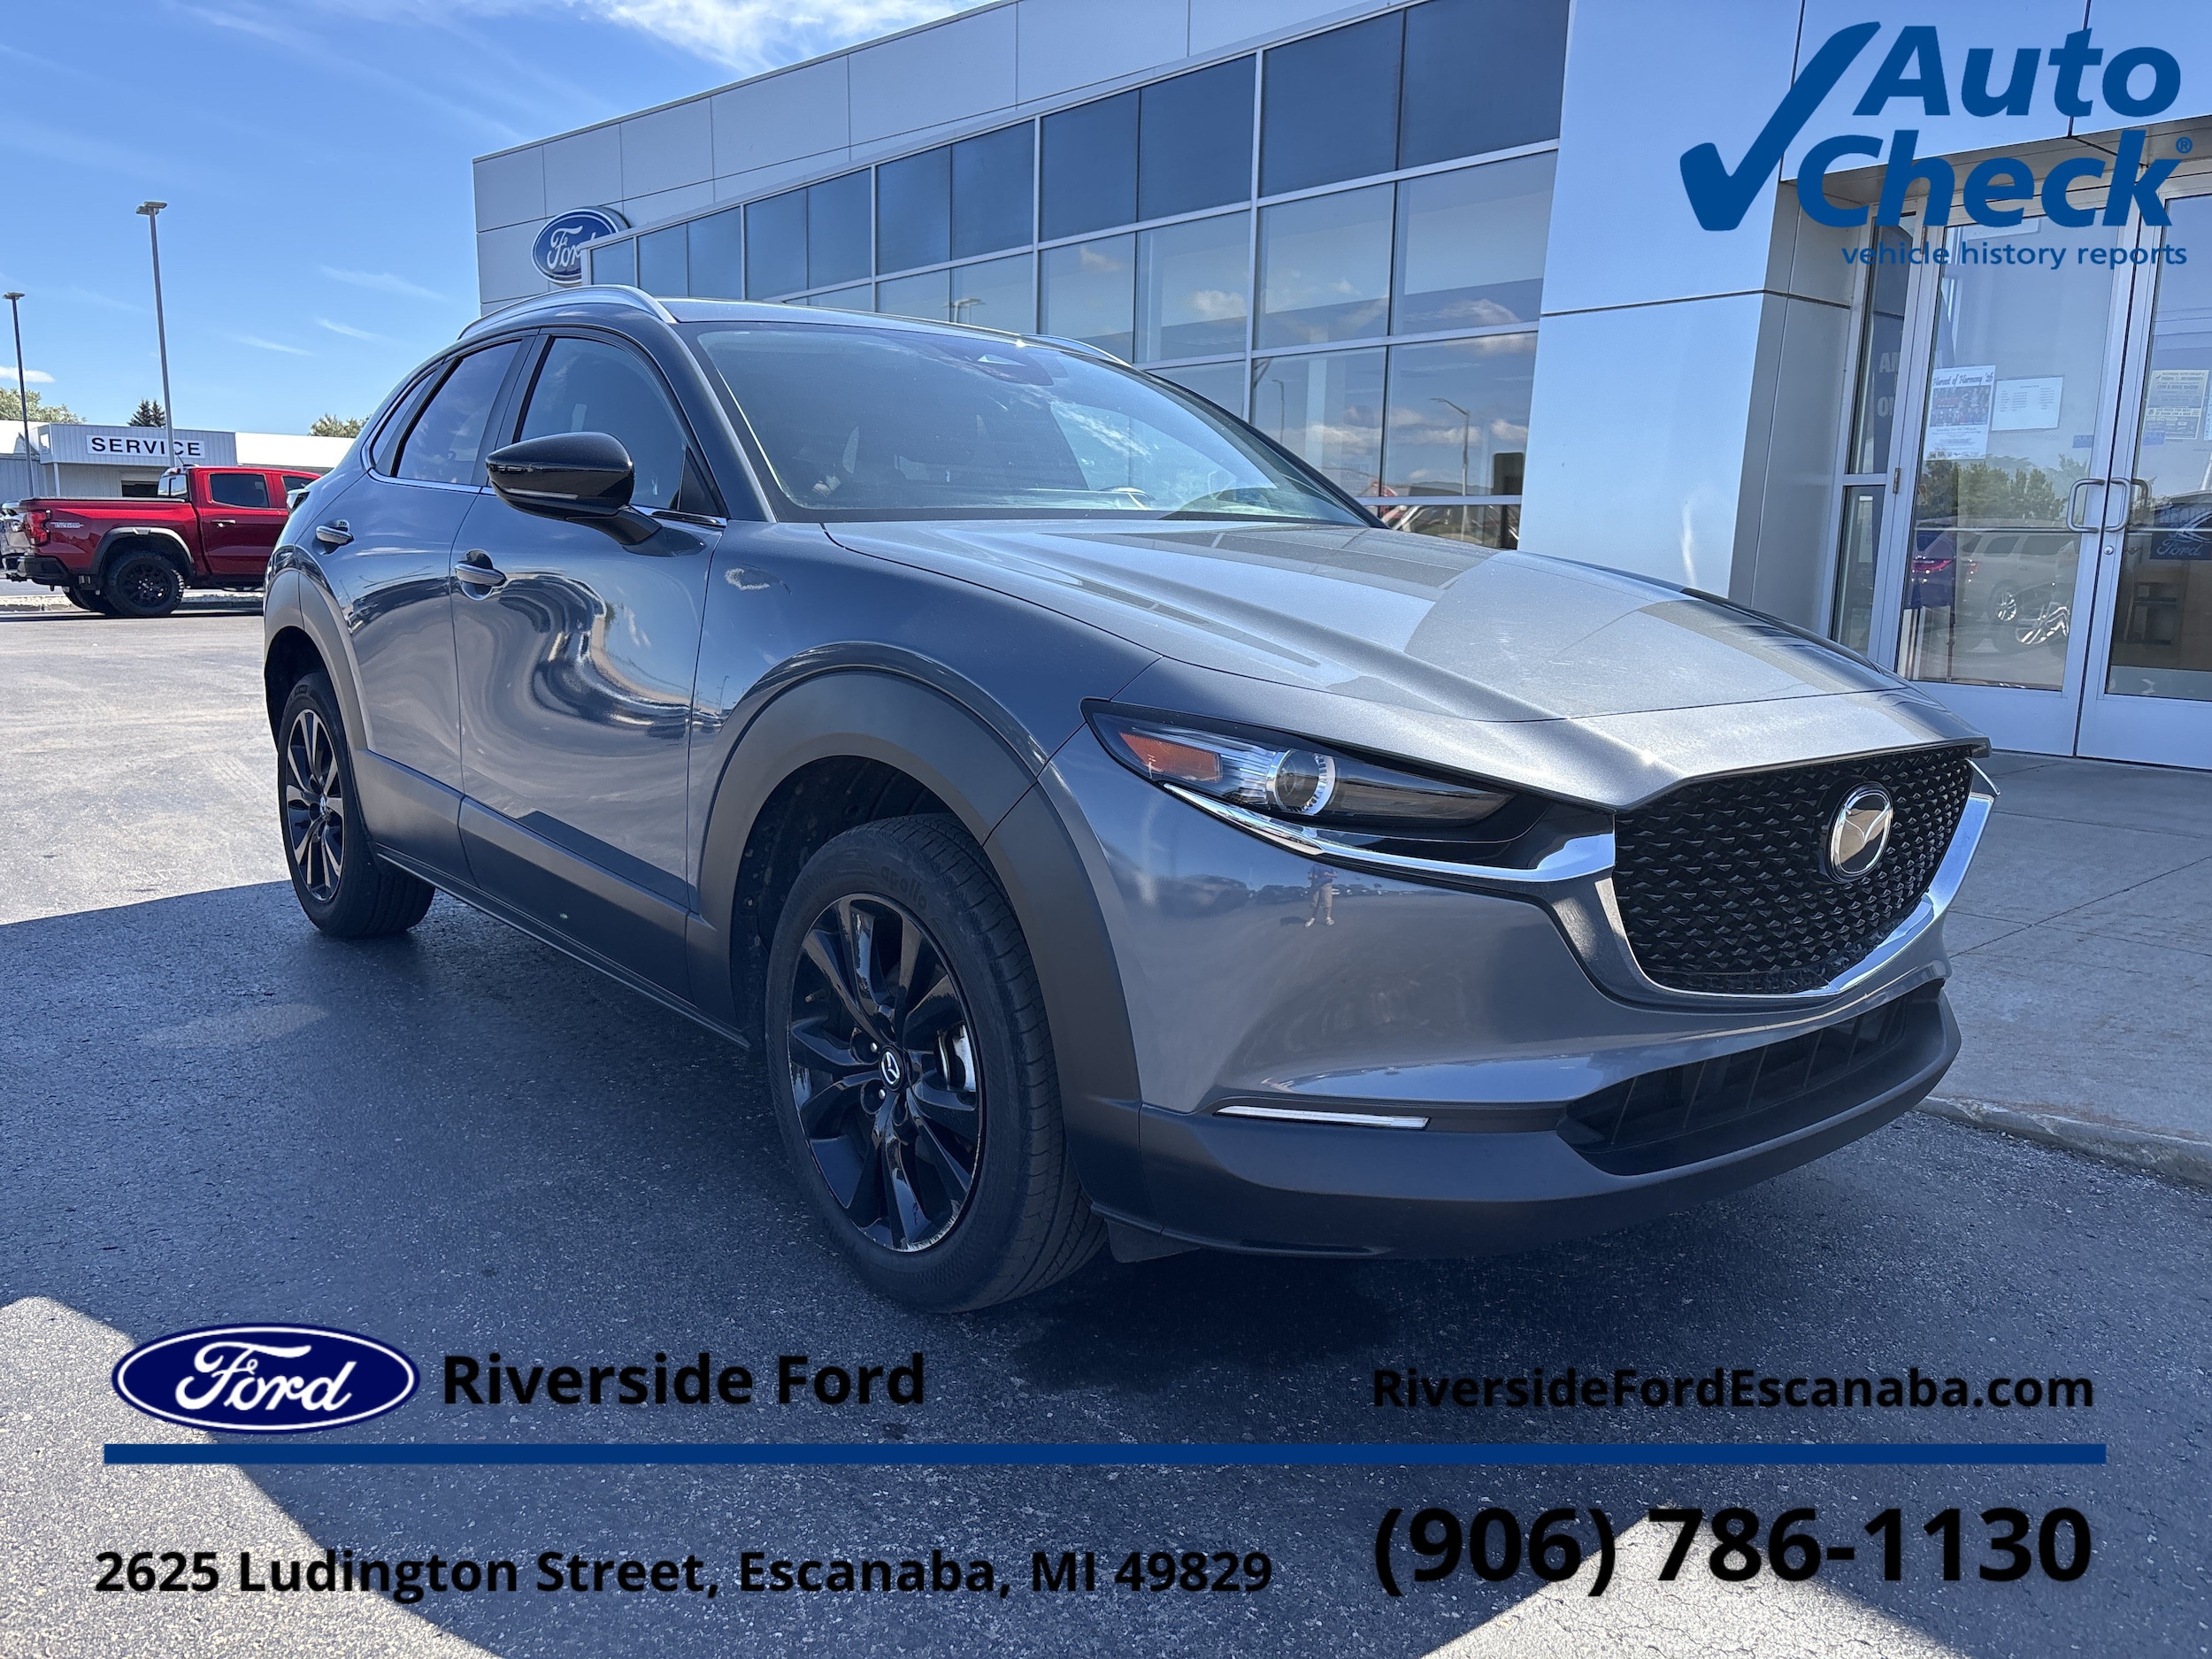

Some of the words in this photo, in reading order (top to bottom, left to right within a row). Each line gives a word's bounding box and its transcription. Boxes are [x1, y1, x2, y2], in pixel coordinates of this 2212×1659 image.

[547, 225, 596, 269] For
[91, 437, 201, 456] SERVICE
[879, 865, 927, 910] apollo
